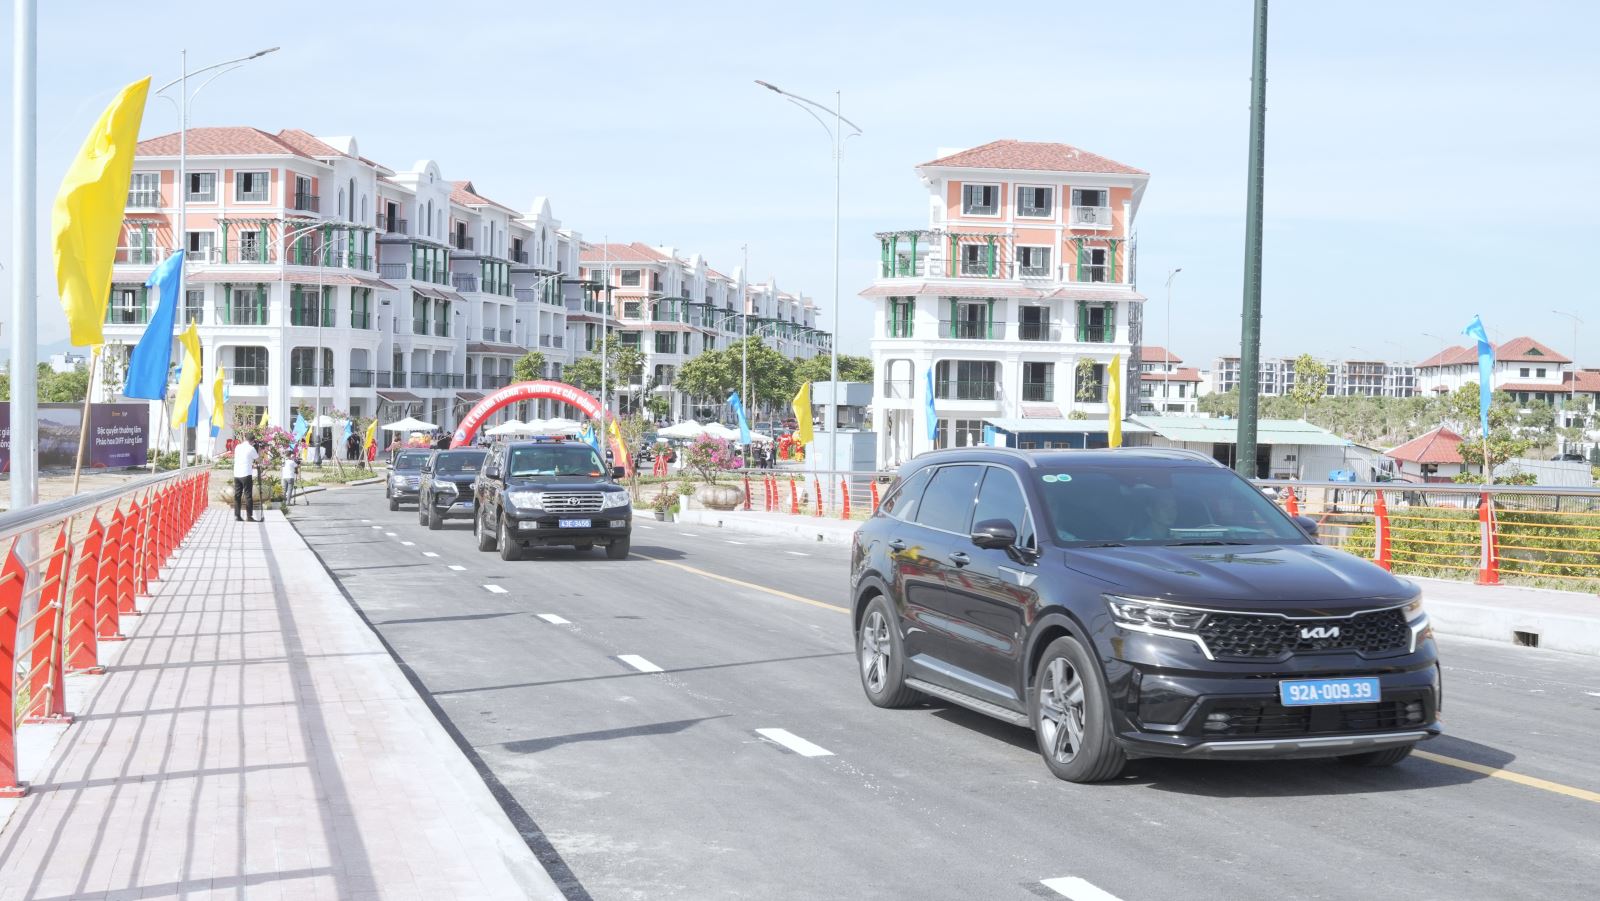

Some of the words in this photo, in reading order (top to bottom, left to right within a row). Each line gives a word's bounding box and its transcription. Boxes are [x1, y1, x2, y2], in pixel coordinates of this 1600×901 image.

[551, 386, 562, 395] XE
[1301, 627, 1340, 639] KIA
[1289, 682, 1371, 701] 92A-009.39
